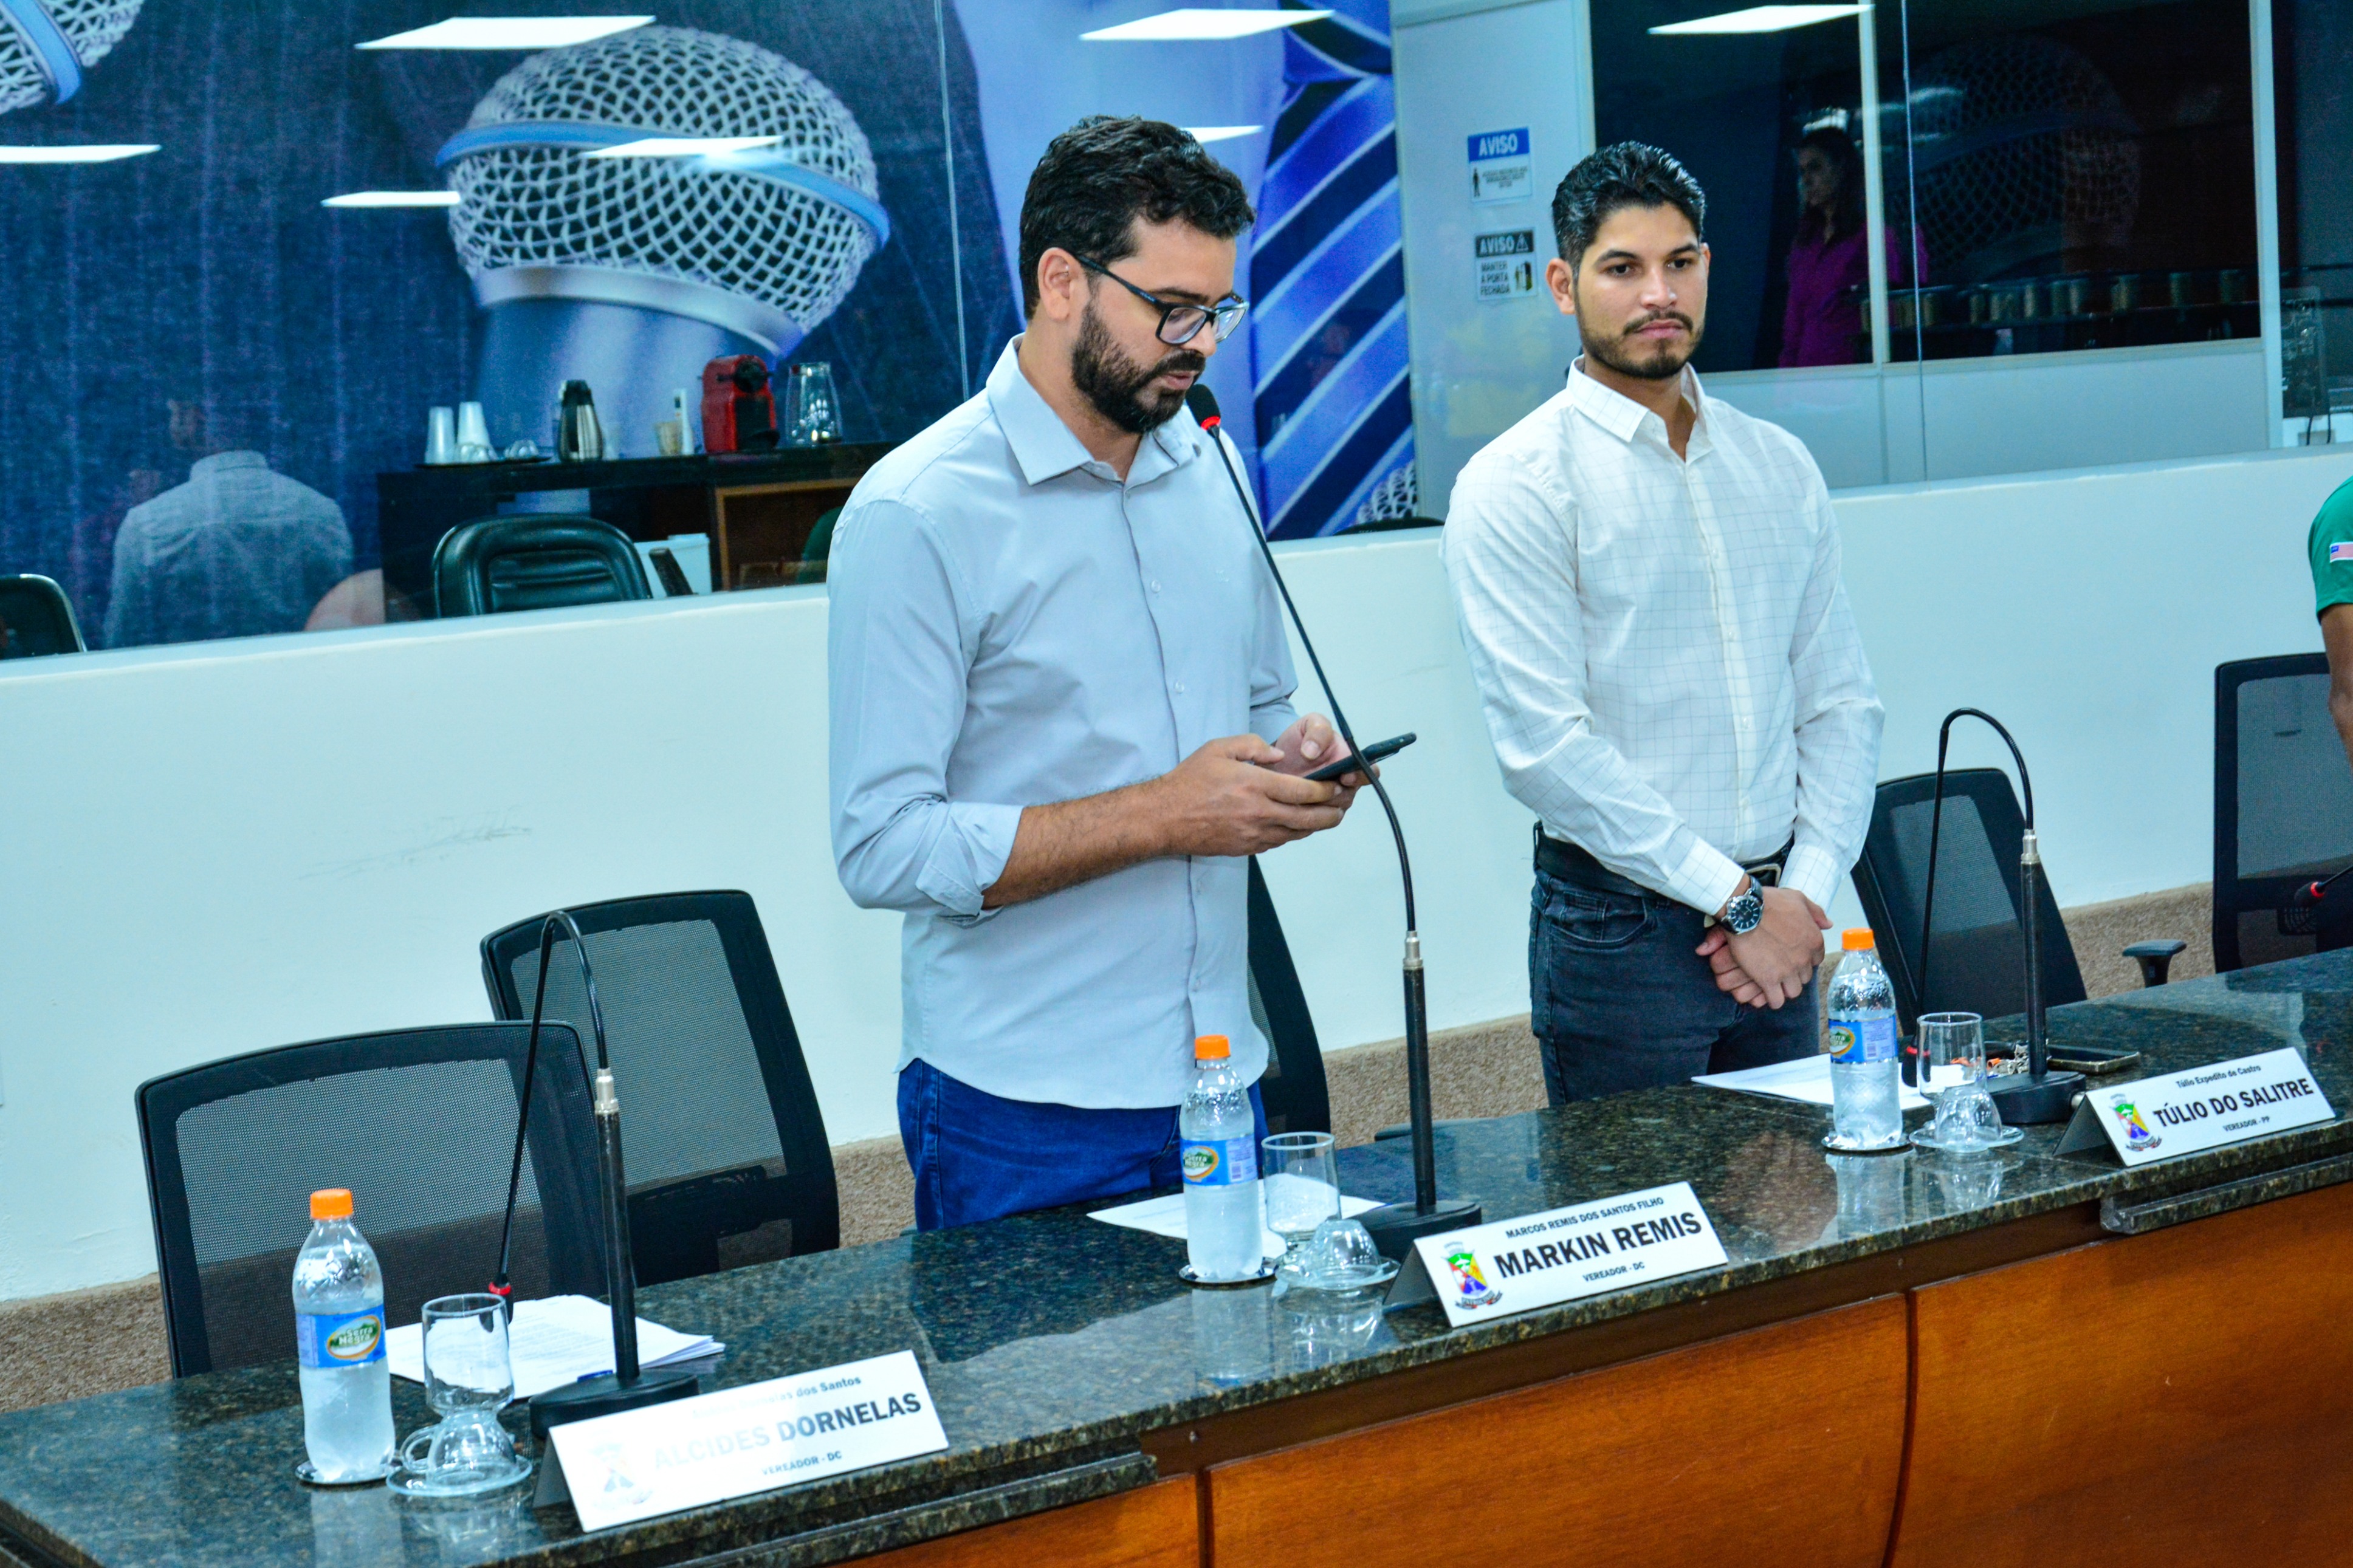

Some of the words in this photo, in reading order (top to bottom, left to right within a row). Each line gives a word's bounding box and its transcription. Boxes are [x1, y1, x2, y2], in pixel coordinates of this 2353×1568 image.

[1479, 133, 1518, 157] AVISO
[1480, 235, 1515, 255] AVISO
[1481, 260, 1508, 272] MANTER
[1486, 271, 1509, 282] PORTA
[1480, 284, 1511, 295] FECHADA
[2176, 1078, 2195, 1088] Túlio
[2195, 1072, 2227, 1084] Expedito
[2238, 1065, 2261, 1075] Castro
[2152, 1102, 2208, 1127] TÚLIO
[2208, 1095, 2238, 1115] DO
[2239, 1078, 2314, 1108] SALITRE
[2223, 1118, 2258, 1132] VEREADOR
[1505, 1222, 1547, 1239] MARCOS
[1548, 1215, 1578, 1230] REMIS
[1579, 1211, 1599, 1223] DOS
[1600, 1203, 1637, 1218] SANTOS
[1637, 1197, 1664, 1210] FILHO
[1493, 1231, 1611, 1279] MARKIN
[1612, 1211, 1702, 1251] REMIS
[1582, 1265, 1627, 1282] VEREADOR
[1632, 1261, 1646, 1271] DC
[338, 1333, 370, 1345] Negra
[346, 1326, 373, 1337] Serra
[796, 1385, 818, 1397] dos
[820, 1377, 862, 1392] Santos
[653, 1426, 771, 1470] ALCIDES
[777, 1392, 922, 1442] DORNELAS
[761, 1456, 819, 1476] VEREADOR
[826, 1451, 843, 1463] DC
